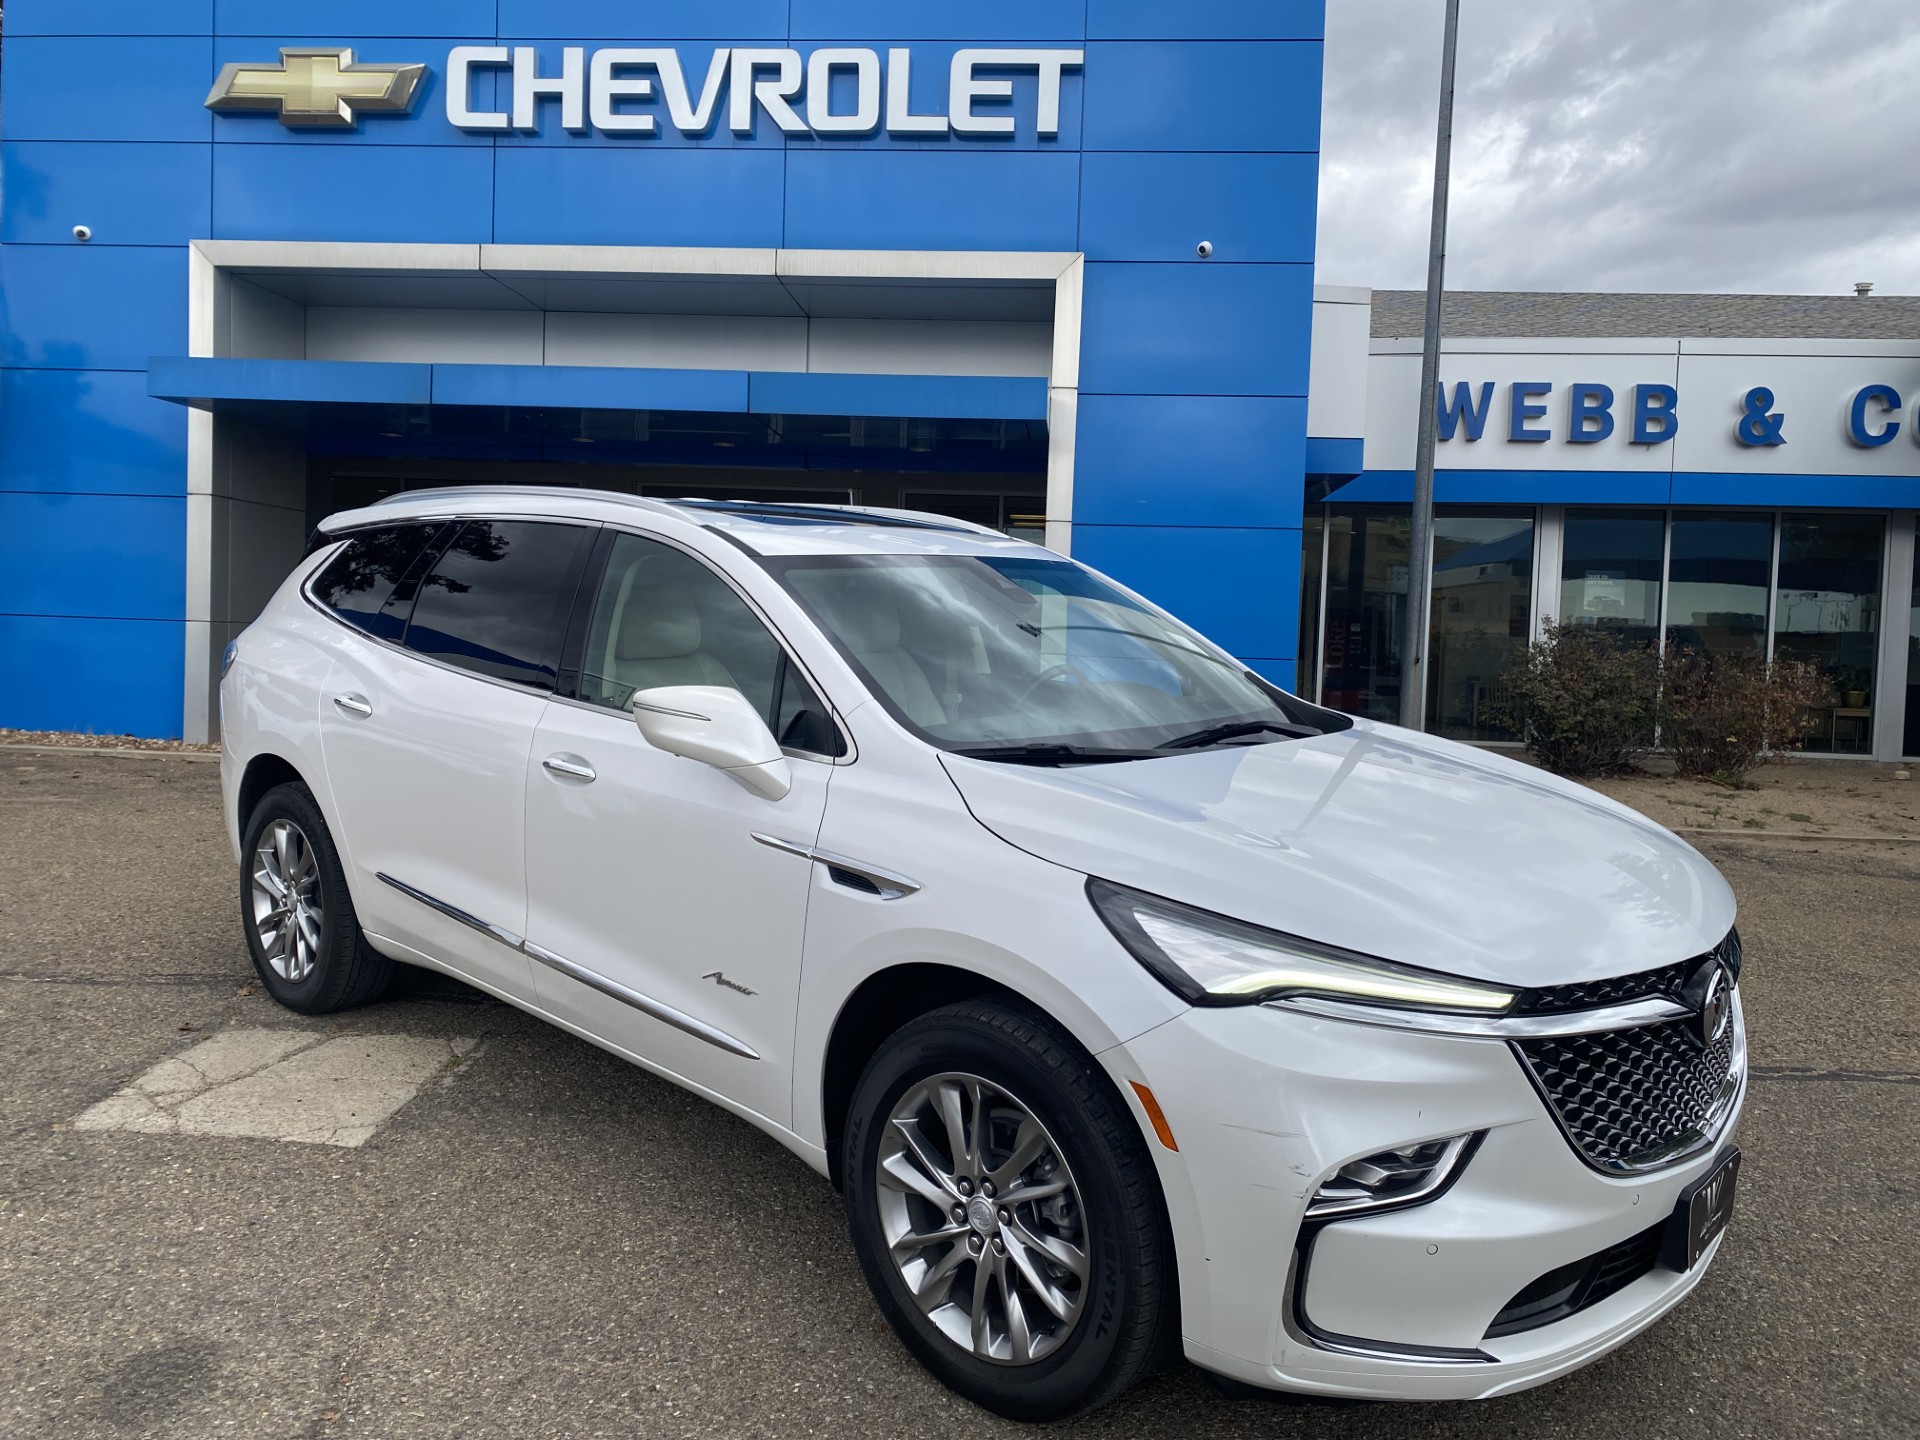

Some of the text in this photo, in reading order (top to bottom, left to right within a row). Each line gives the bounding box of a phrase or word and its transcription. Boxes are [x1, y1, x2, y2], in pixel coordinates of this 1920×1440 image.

[445, 46, 1084, 137] CHEVROLET
[1437, 381, 1920, 450] WEBB & C
